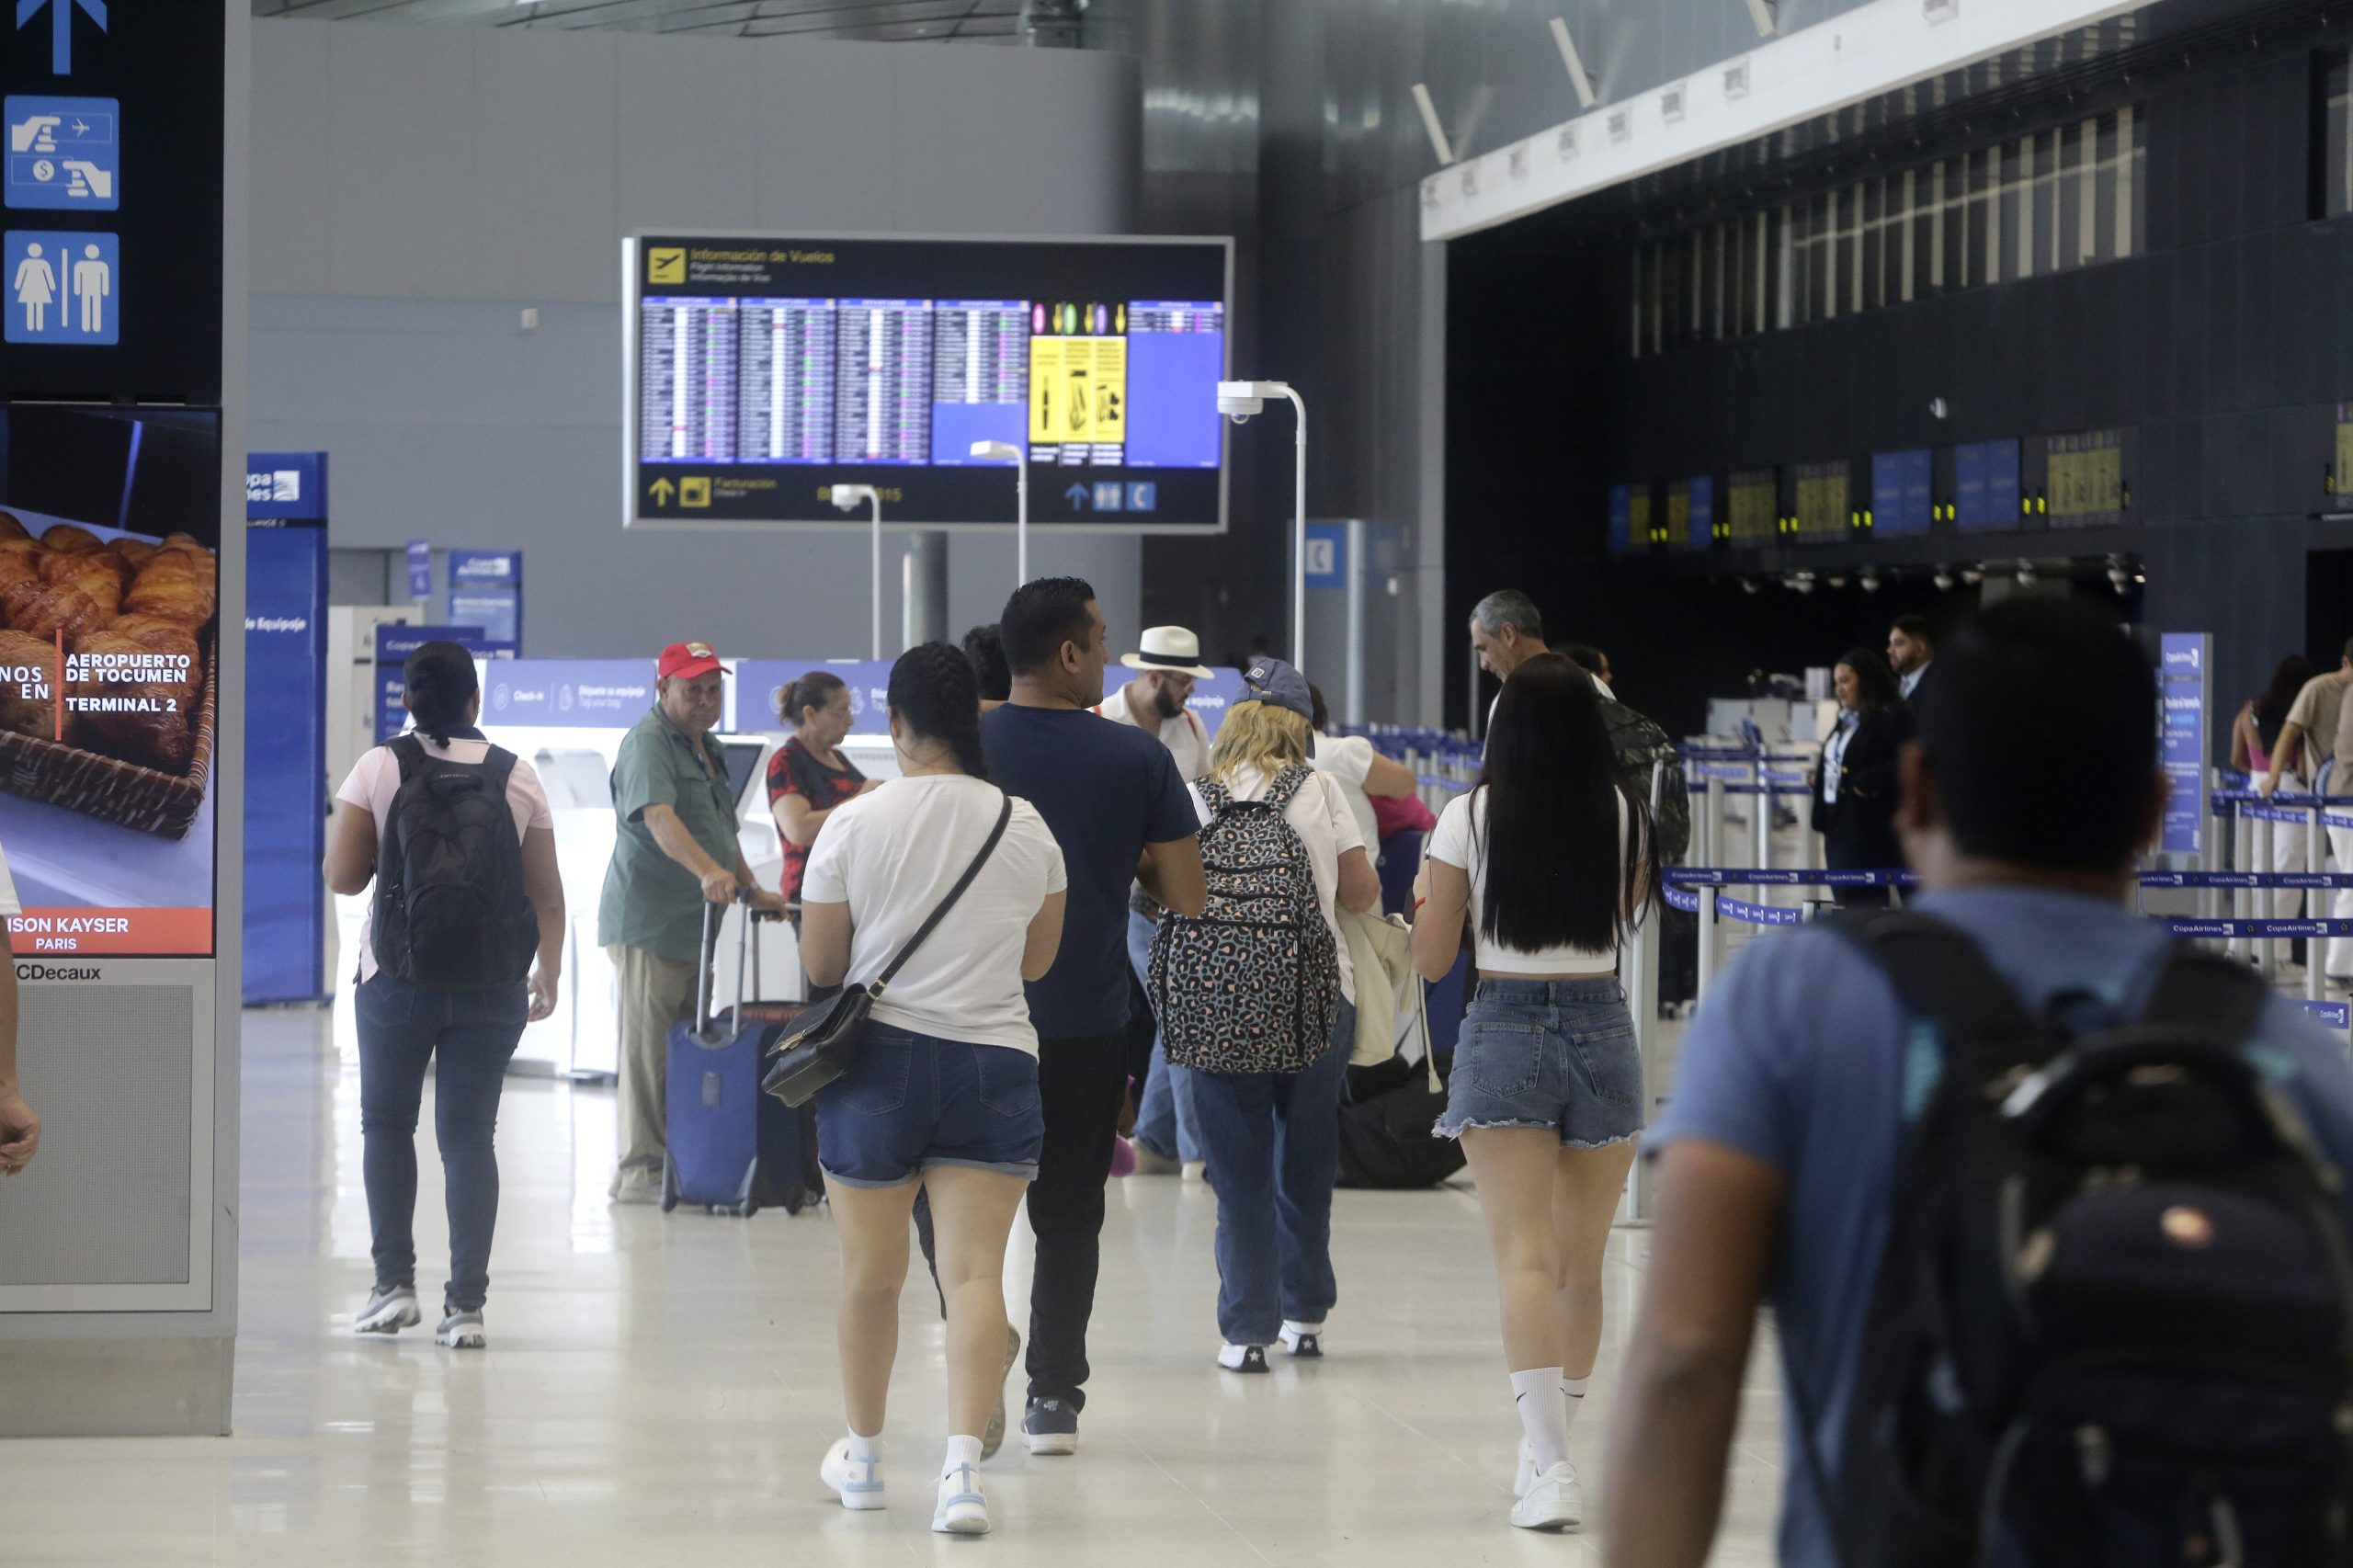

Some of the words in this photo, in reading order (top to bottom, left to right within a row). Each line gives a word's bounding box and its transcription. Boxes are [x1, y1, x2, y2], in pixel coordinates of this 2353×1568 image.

[66, 653, 190, 668] AEROPUERTO
[0, 666, 42, 682] NOS
[66, 669, 89, 682] DE
[96, 669, 187, 683] TOCUMEN
[21, 683, 49, 699] EN
[65, 698, 161, 712] TERMINAL
[166, 699, 176, 712] 2
[7, 917, 51, 933] ISON
[56, 917, 129, 933] KAYSER
[2173, 925, 2222, 934] CopaAirlines
[2267, 924, 2315, 934] CopaAirlines
[36, 937, 77, 950] PARIS
[15, 963, 102, 981] CDecaux
